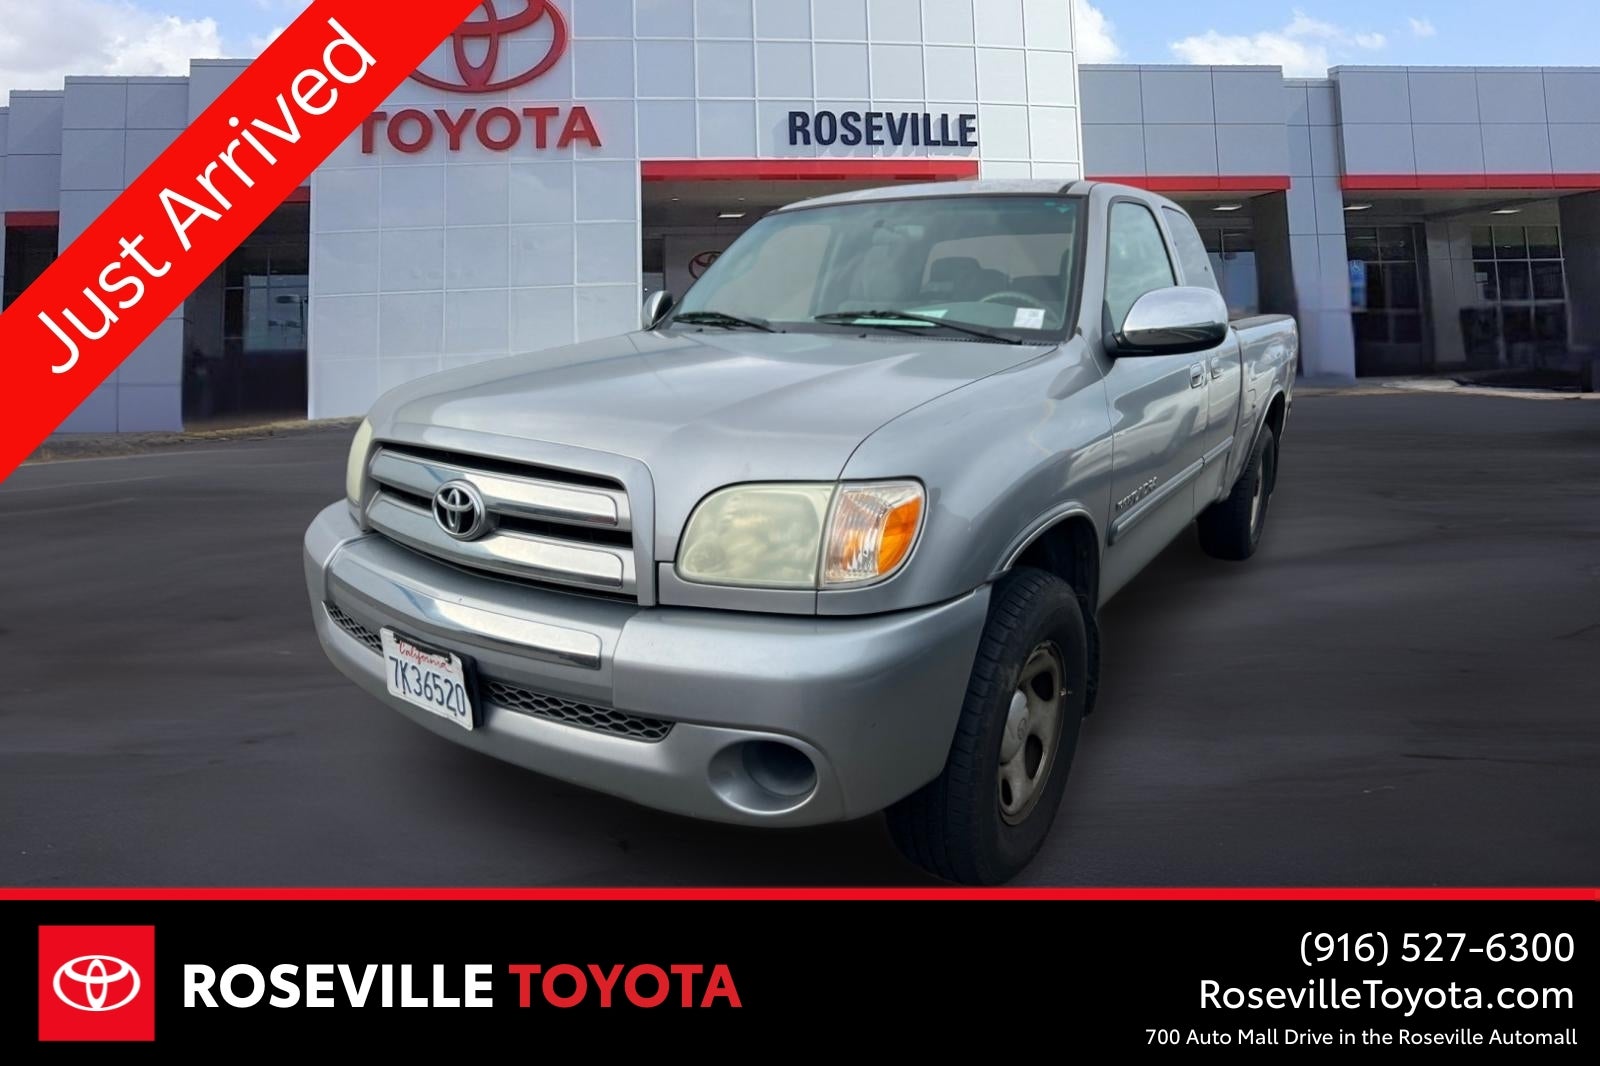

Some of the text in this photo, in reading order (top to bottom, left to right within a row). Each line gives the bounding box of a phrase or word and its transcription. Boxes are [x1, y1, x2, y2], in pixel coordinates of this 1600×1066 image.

[361, 106, 602, 154] TOYOTA
[788, 111, 978, 147] ROSEVILLE
[389, 655, 466, 717] 7K36520
